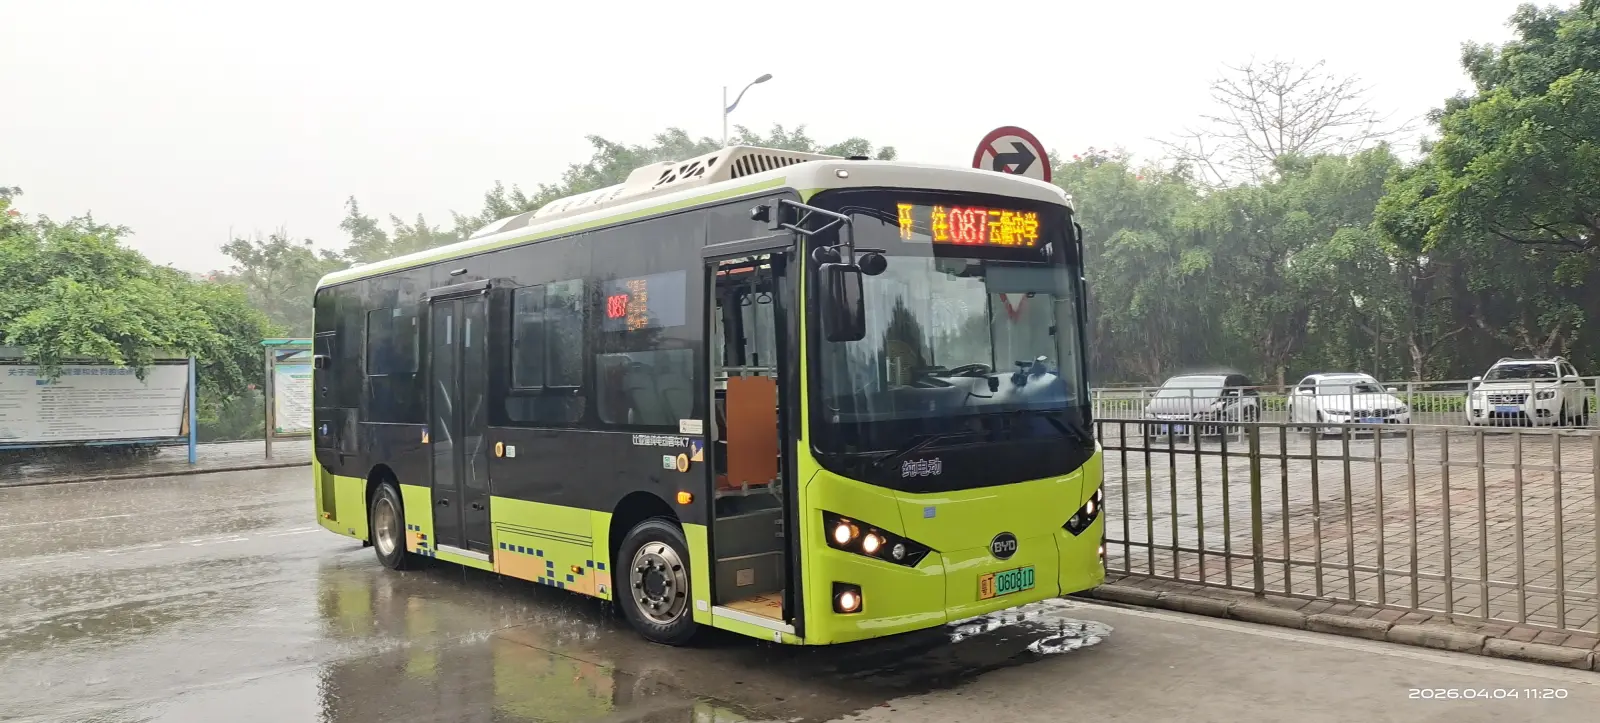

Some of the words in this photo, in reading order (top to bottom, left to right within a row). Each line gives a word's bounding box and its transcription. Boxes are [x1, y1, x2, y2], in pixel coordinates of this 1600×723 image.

[897, 203, 912, 240] 开
[931, 205, 948, 241] 往
[949, 208, 987, 243] 087
[607, 294, 628, 318] 087
[901, 457, 942, 478] 纯电动
[994, 539, 1016, 553] BYD
